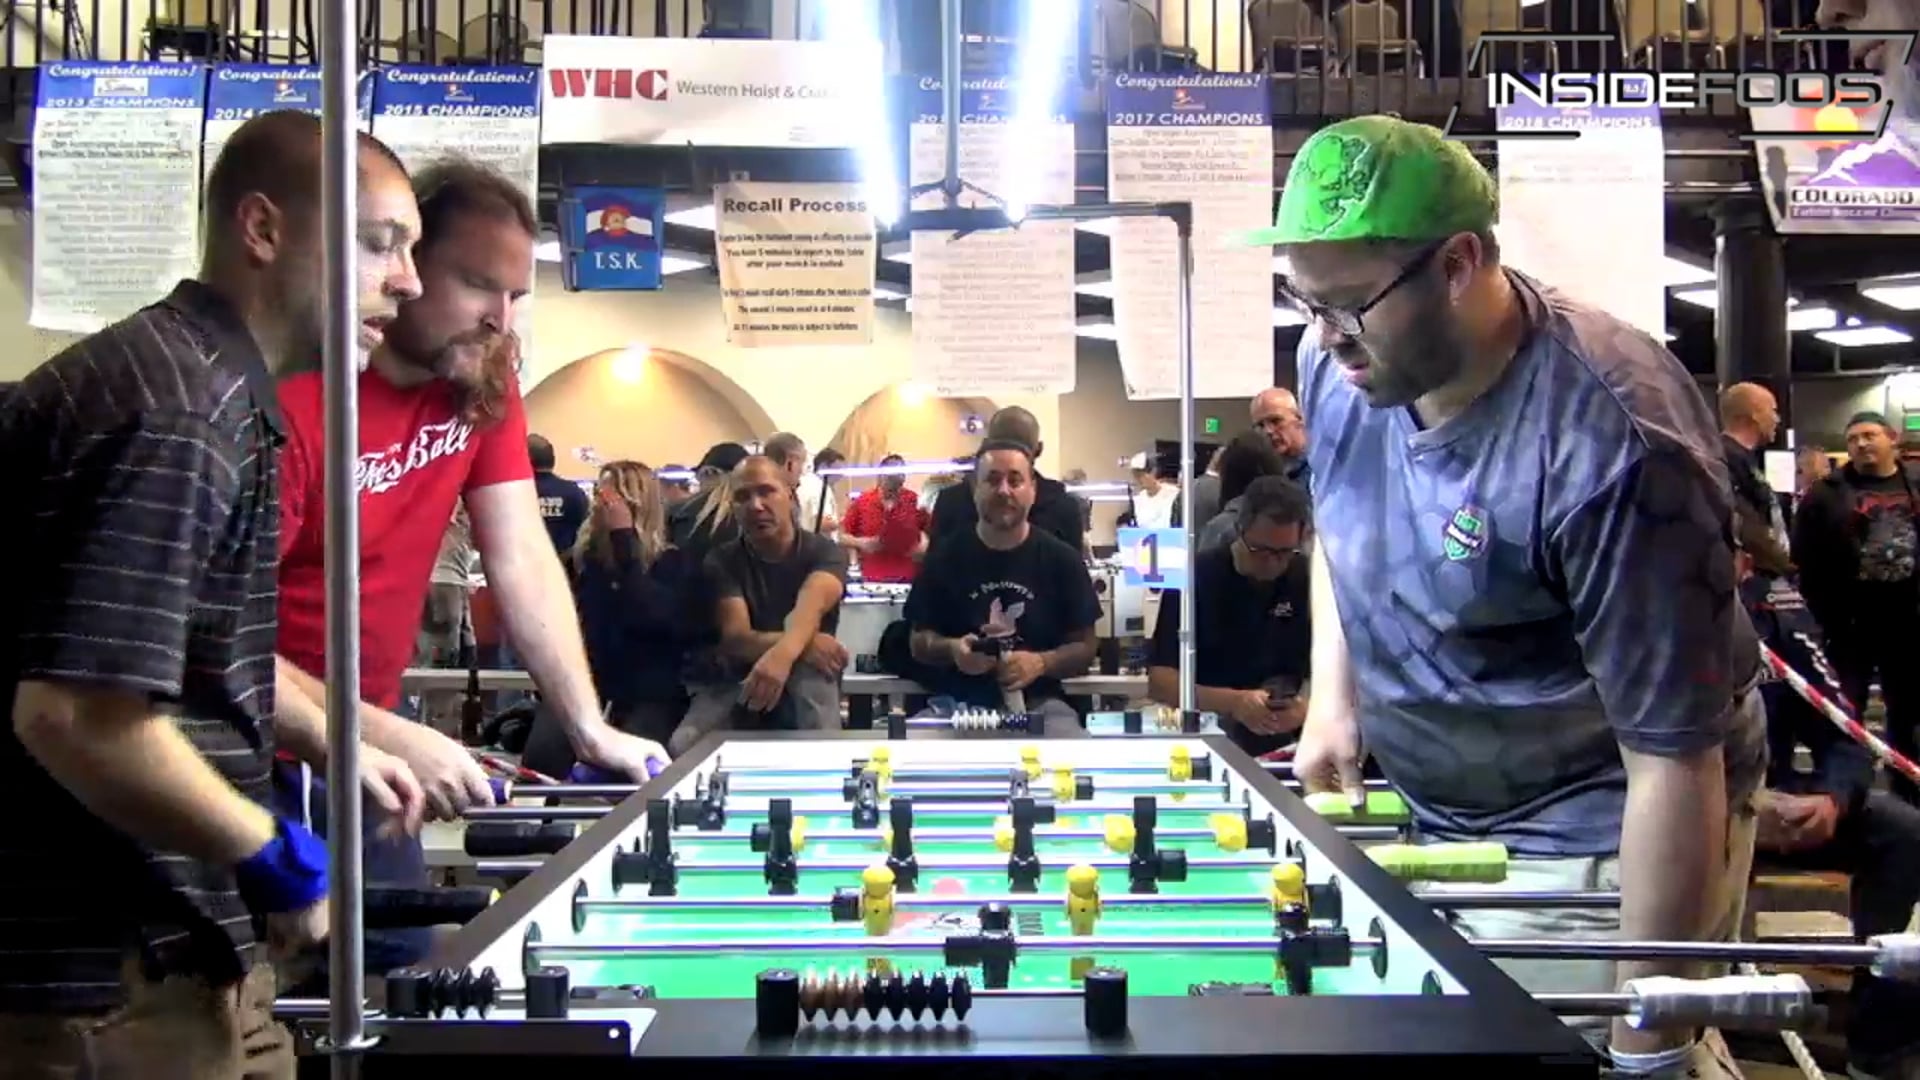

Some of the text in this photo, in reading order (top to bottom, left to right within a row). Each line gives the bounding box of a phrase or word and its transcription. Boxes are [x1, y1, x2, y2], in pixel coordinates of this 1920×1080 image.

[49, 64, 197, 78] Congratulations!
[387, 69, 534, 84] Congratulations!
[549, 69, 668, 100] WHC
[1116, 73, 1261, 90] Congratulations!
[676, 81, 738, 97] Western
[741, 84, 780, 99] Hoist
[783, 86, 794, 98] &
[90, 99, 195, 107] CHAMPIONS
[215, 108, 253, 120] 2014
[384, 104, 534, 118] 2015 CHAMPIONS
[1115, 113, 1263, 125] 2017 CHAMPIONS
[1548, 117, 1652, 128] CHAMPIONS
[1791, 189, 1914, 204] COLORADO
[723, 198, 867, 213] Recall Process
[1141, 533, 1165, 583] 1
